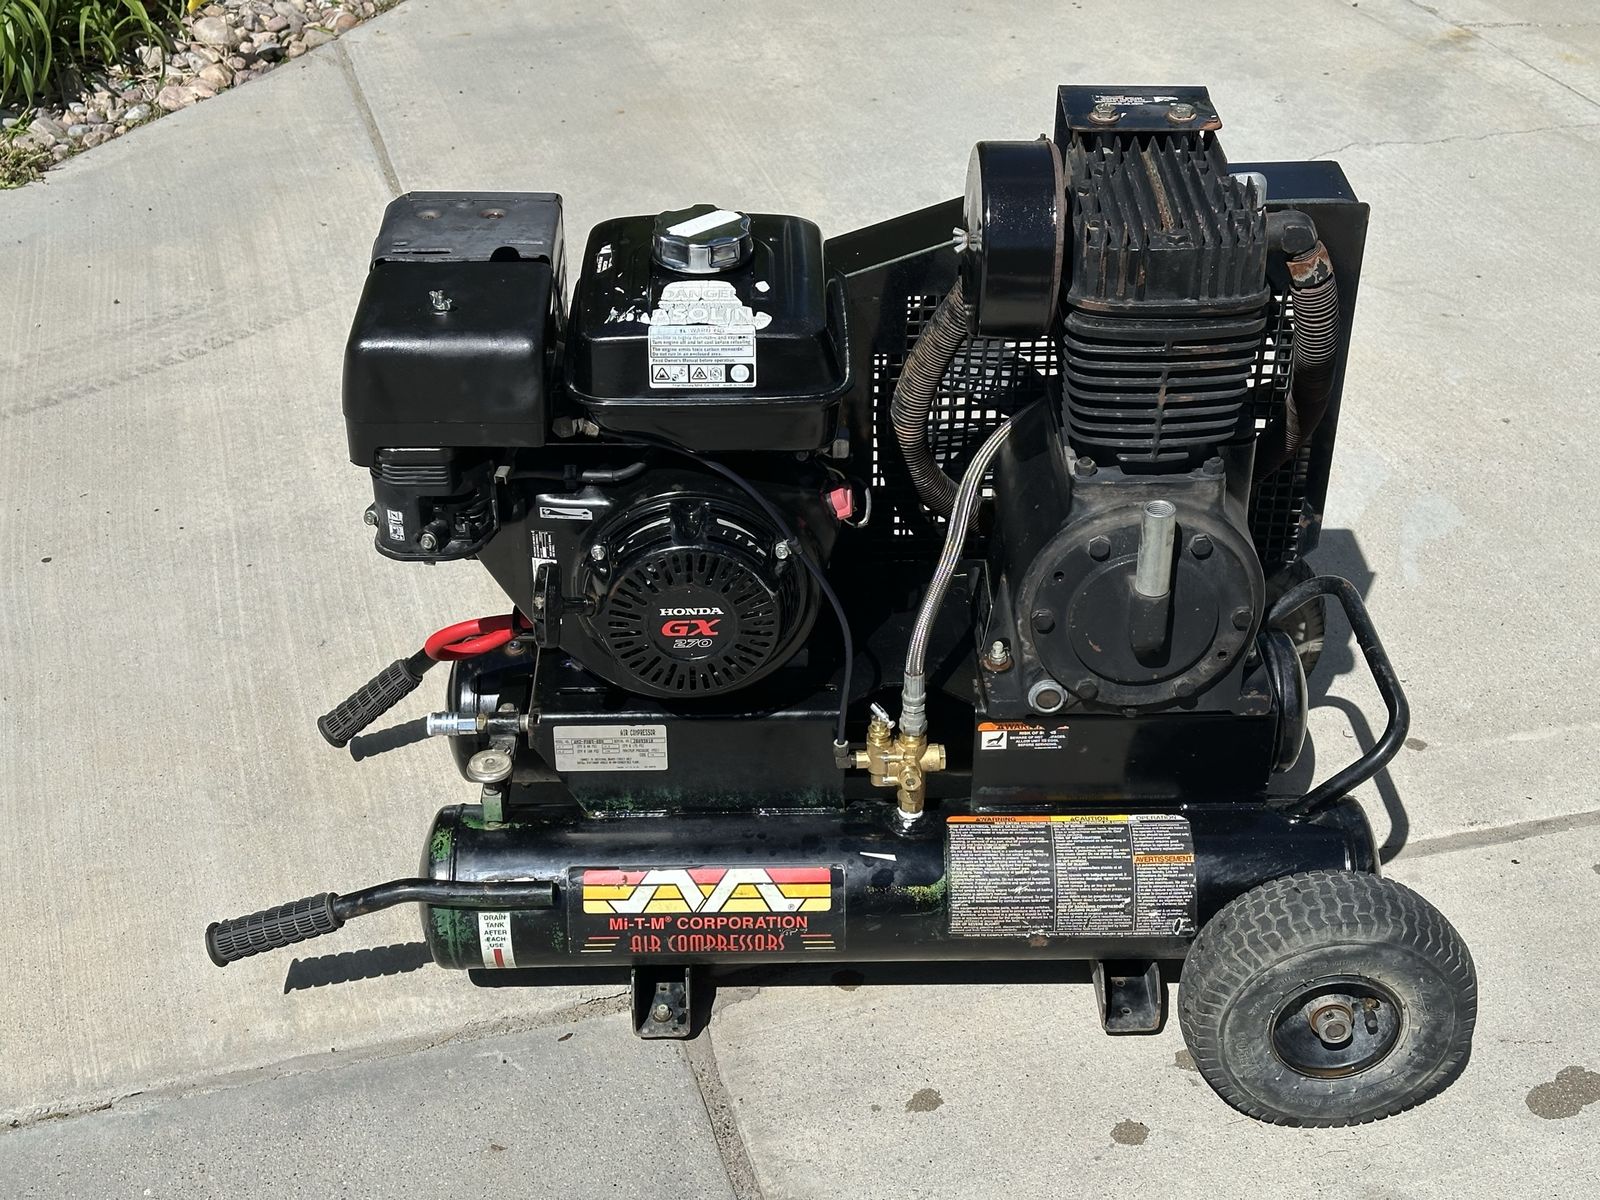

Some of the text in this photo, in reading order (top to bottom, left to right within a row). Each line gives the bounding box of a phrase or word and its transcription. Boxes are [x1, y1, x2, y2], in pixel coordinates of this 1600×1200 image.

[659, 607, 724, 616] HONDA
[661, 619, 721, 637] GX
[673, 638, 713, 649] 270
[629, 728, 656, 736] COMPRESSOR
[1135, 855, 1193, 863] AVERTISSEMENT
[677, 916, 808, 929] CORPORATION
[630, 934, 785, 952] AIR COMPRESSORS
